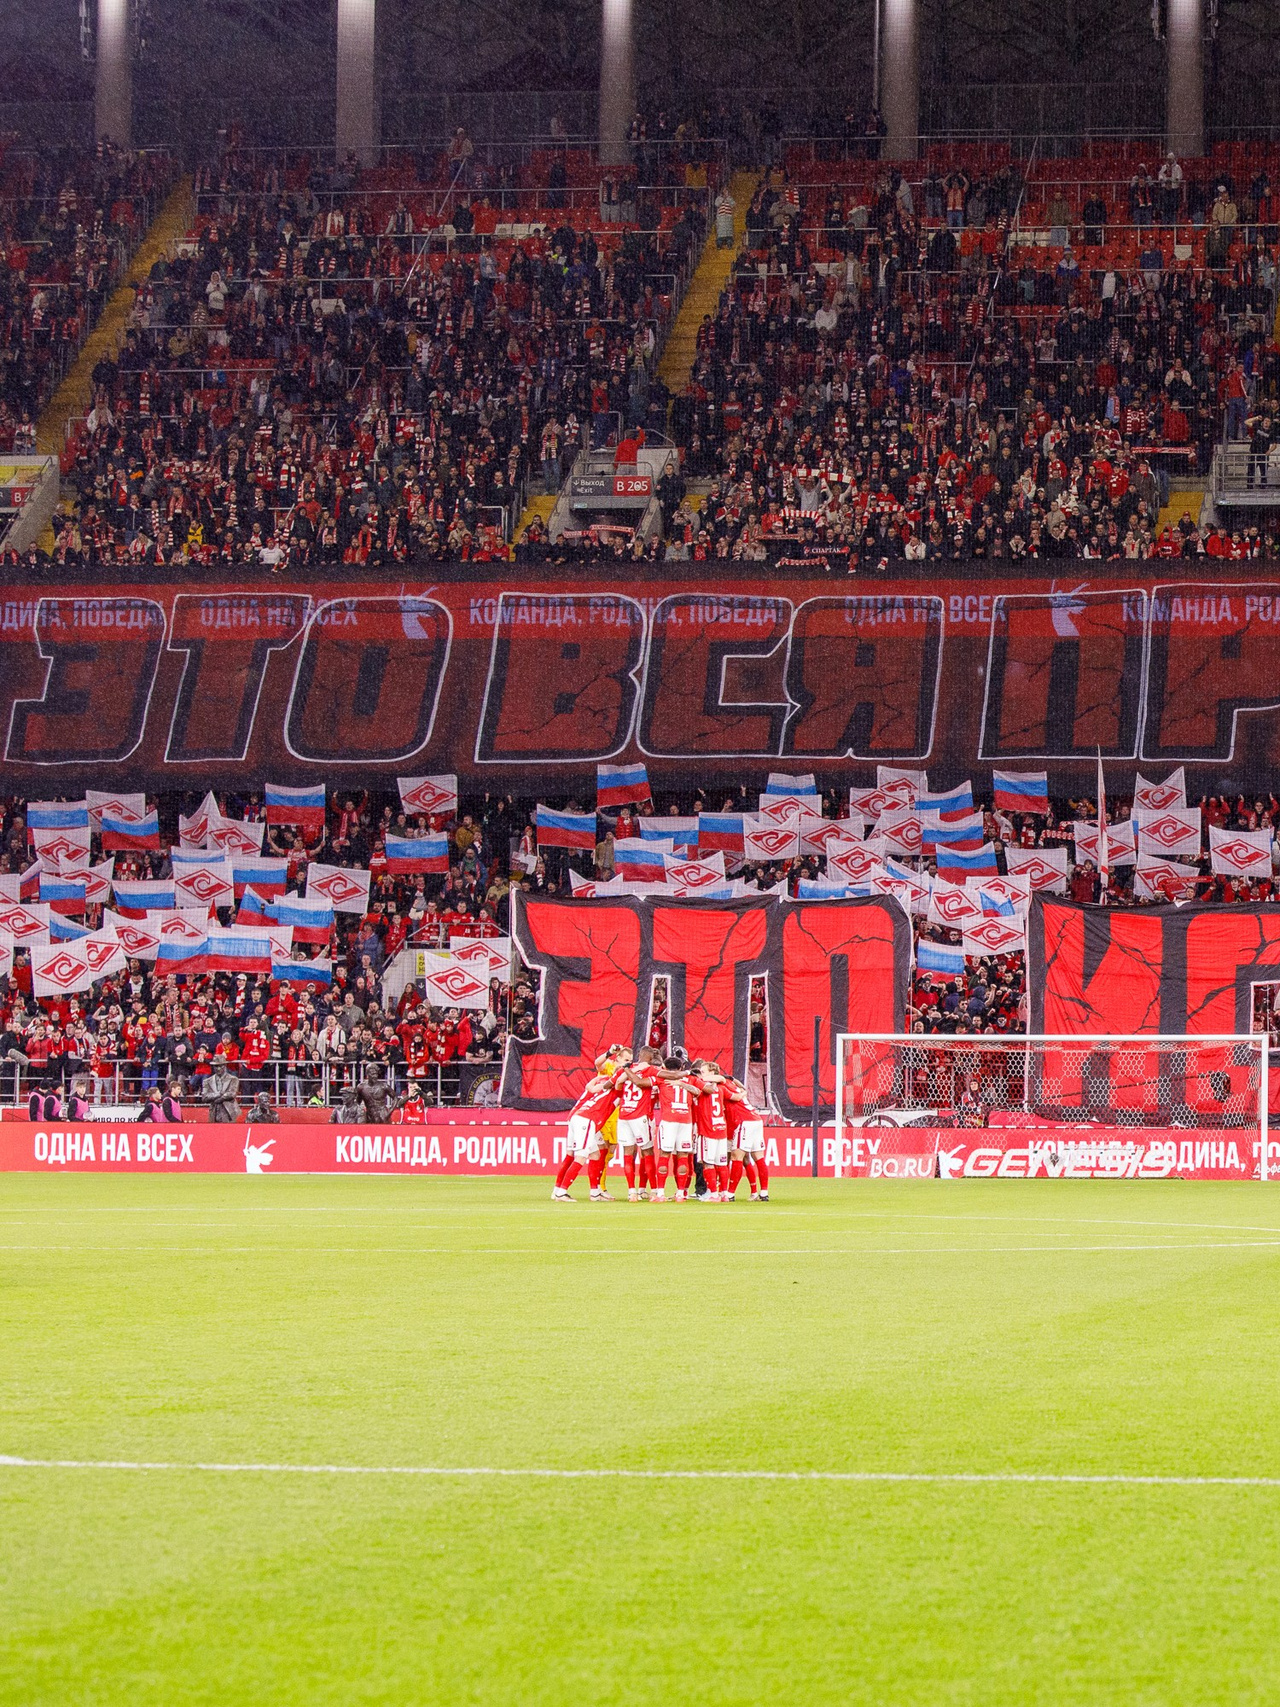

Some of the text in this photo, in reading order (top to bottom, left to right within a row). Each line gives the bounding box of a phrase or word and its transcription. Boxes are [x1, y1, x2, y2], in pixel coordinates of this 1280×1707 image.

[0, 600, 67, 629] ДИНА,
[201, 599, 259, 630] ОДНА
[469, 597, 582, 630] КОМАНДА,
[845, 595, 909, 627] ОДНА
[949, 595, 1006, 624] ВСЕХ
[1121, 595, 1239, 628] КОМАНДА,
[4, 593, 452, 764] ЭТО
[475, 593, 945, 763] ВСЯ
[623, 1080, 643, 1101] 35
[673, 1085, 688, 1104] 11
[712, 1093, 720, 1117] 5
[34, 1133, 193, 1163] ОДНА НА ВСЕХ
[336, 1136, 447, 1167] КОМАНДА,
[453, 1136, 547, 1167] РОДИНА,
[786, 1138, 814, 1166] НА
[963, 1148, 1177, 1178] GENESIS
